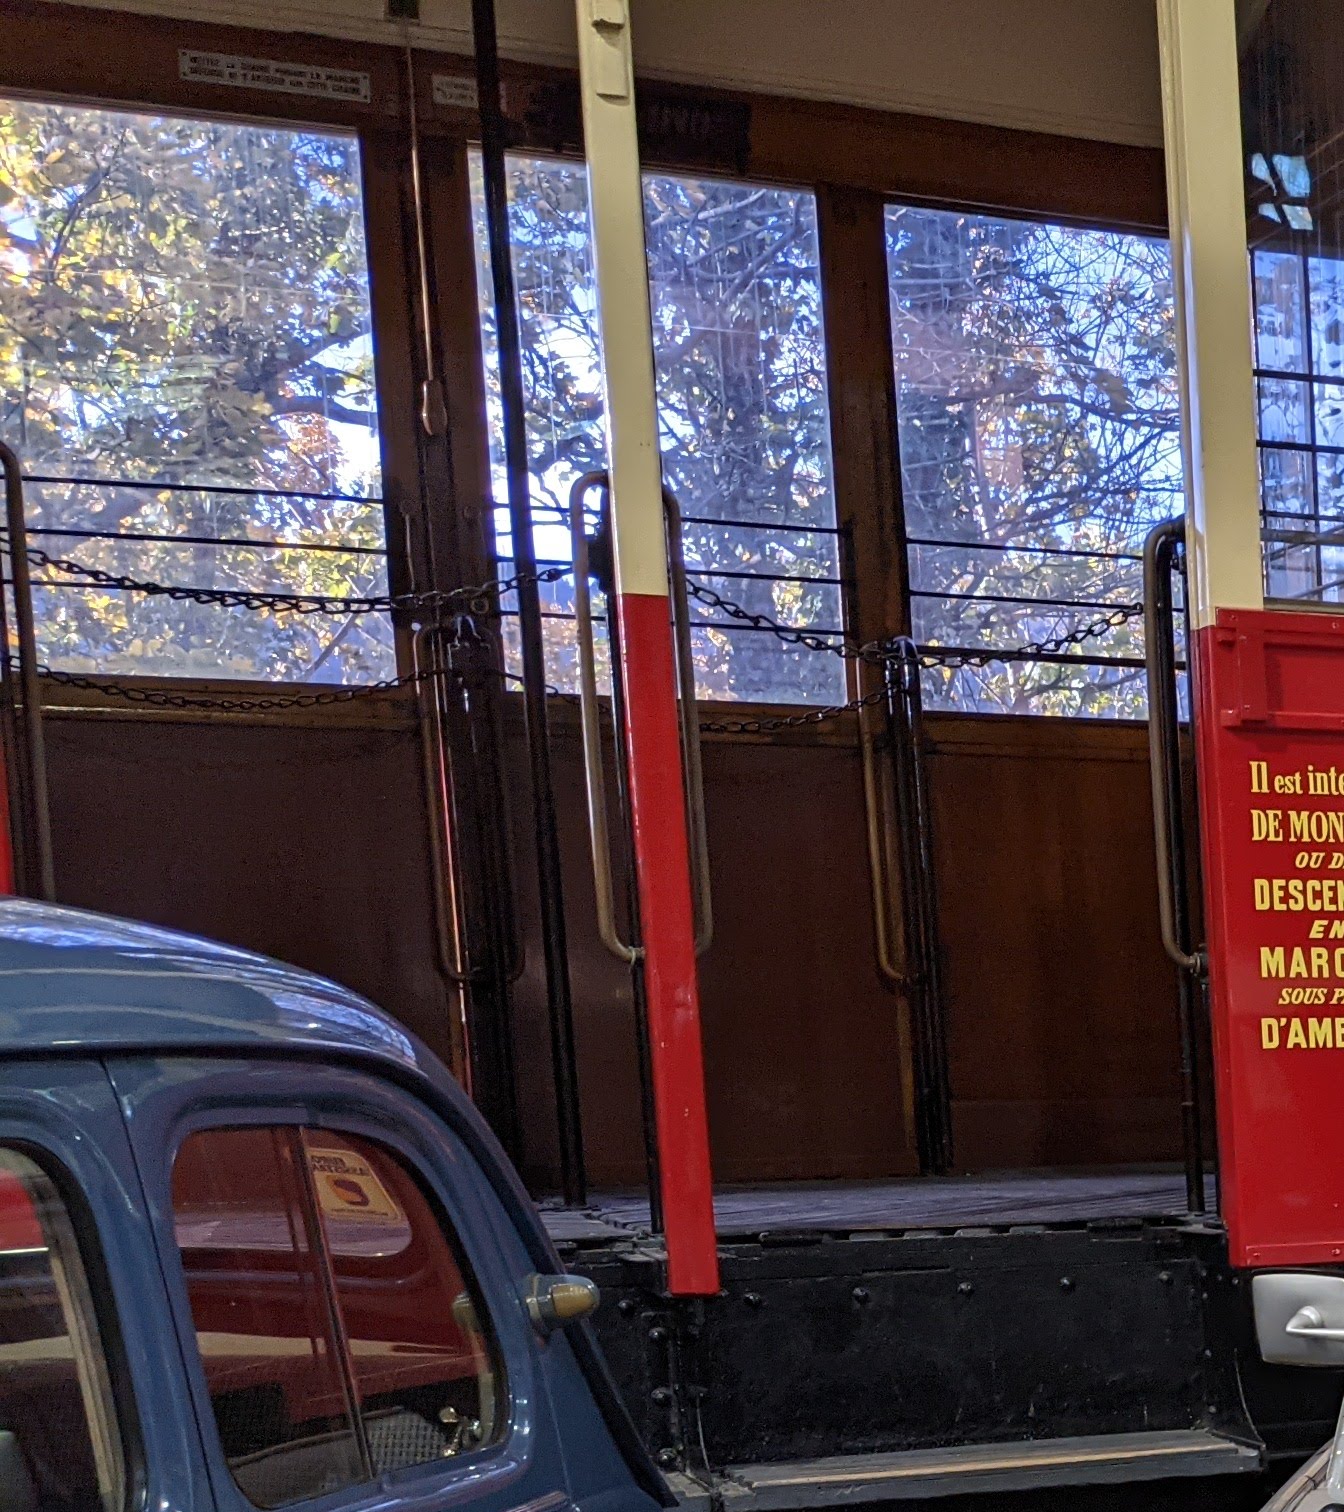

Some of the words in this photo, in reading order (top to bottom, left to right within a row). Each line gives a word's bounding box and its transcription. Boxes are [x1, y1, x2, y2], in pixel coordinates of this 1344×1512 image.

[1249, 761, 1269, 794] Il
[1273, 773, 1303, 795] est
[1250, 809, 1283, 842] DE
[1295, 852, 1324, 869] OU
[1278, 987, 1326, 1005] SOUS
